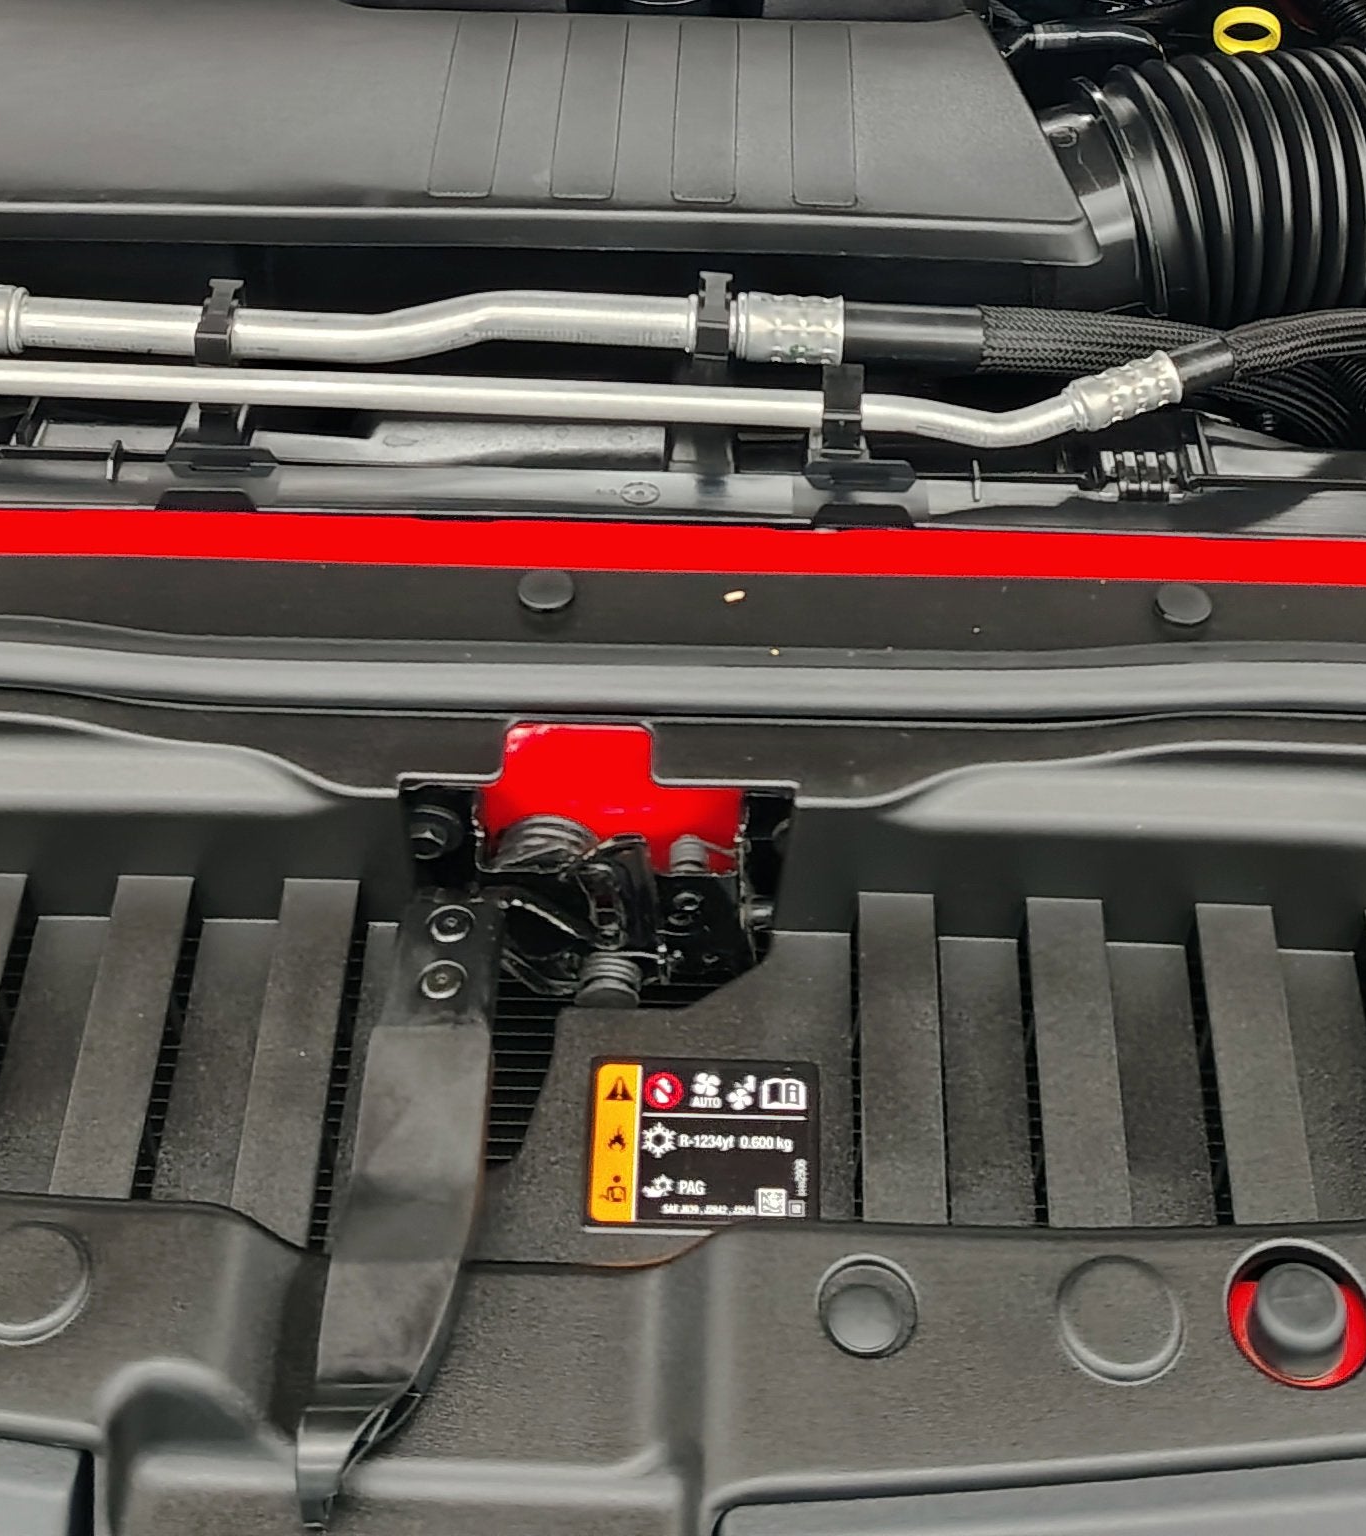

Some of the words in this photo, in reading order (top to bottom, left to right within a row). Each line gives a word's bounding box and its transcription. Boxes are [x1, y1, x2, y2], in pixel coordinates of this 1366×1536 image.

[692, 1096, 722, 1107] AUTO
[678, 1134, 734, 1151] R-1234yf
[739, 1135, 773, 1149] 0.600
[776, 1136, 794, 1152] kg
[679, 1179, 706, 1195] PAG
